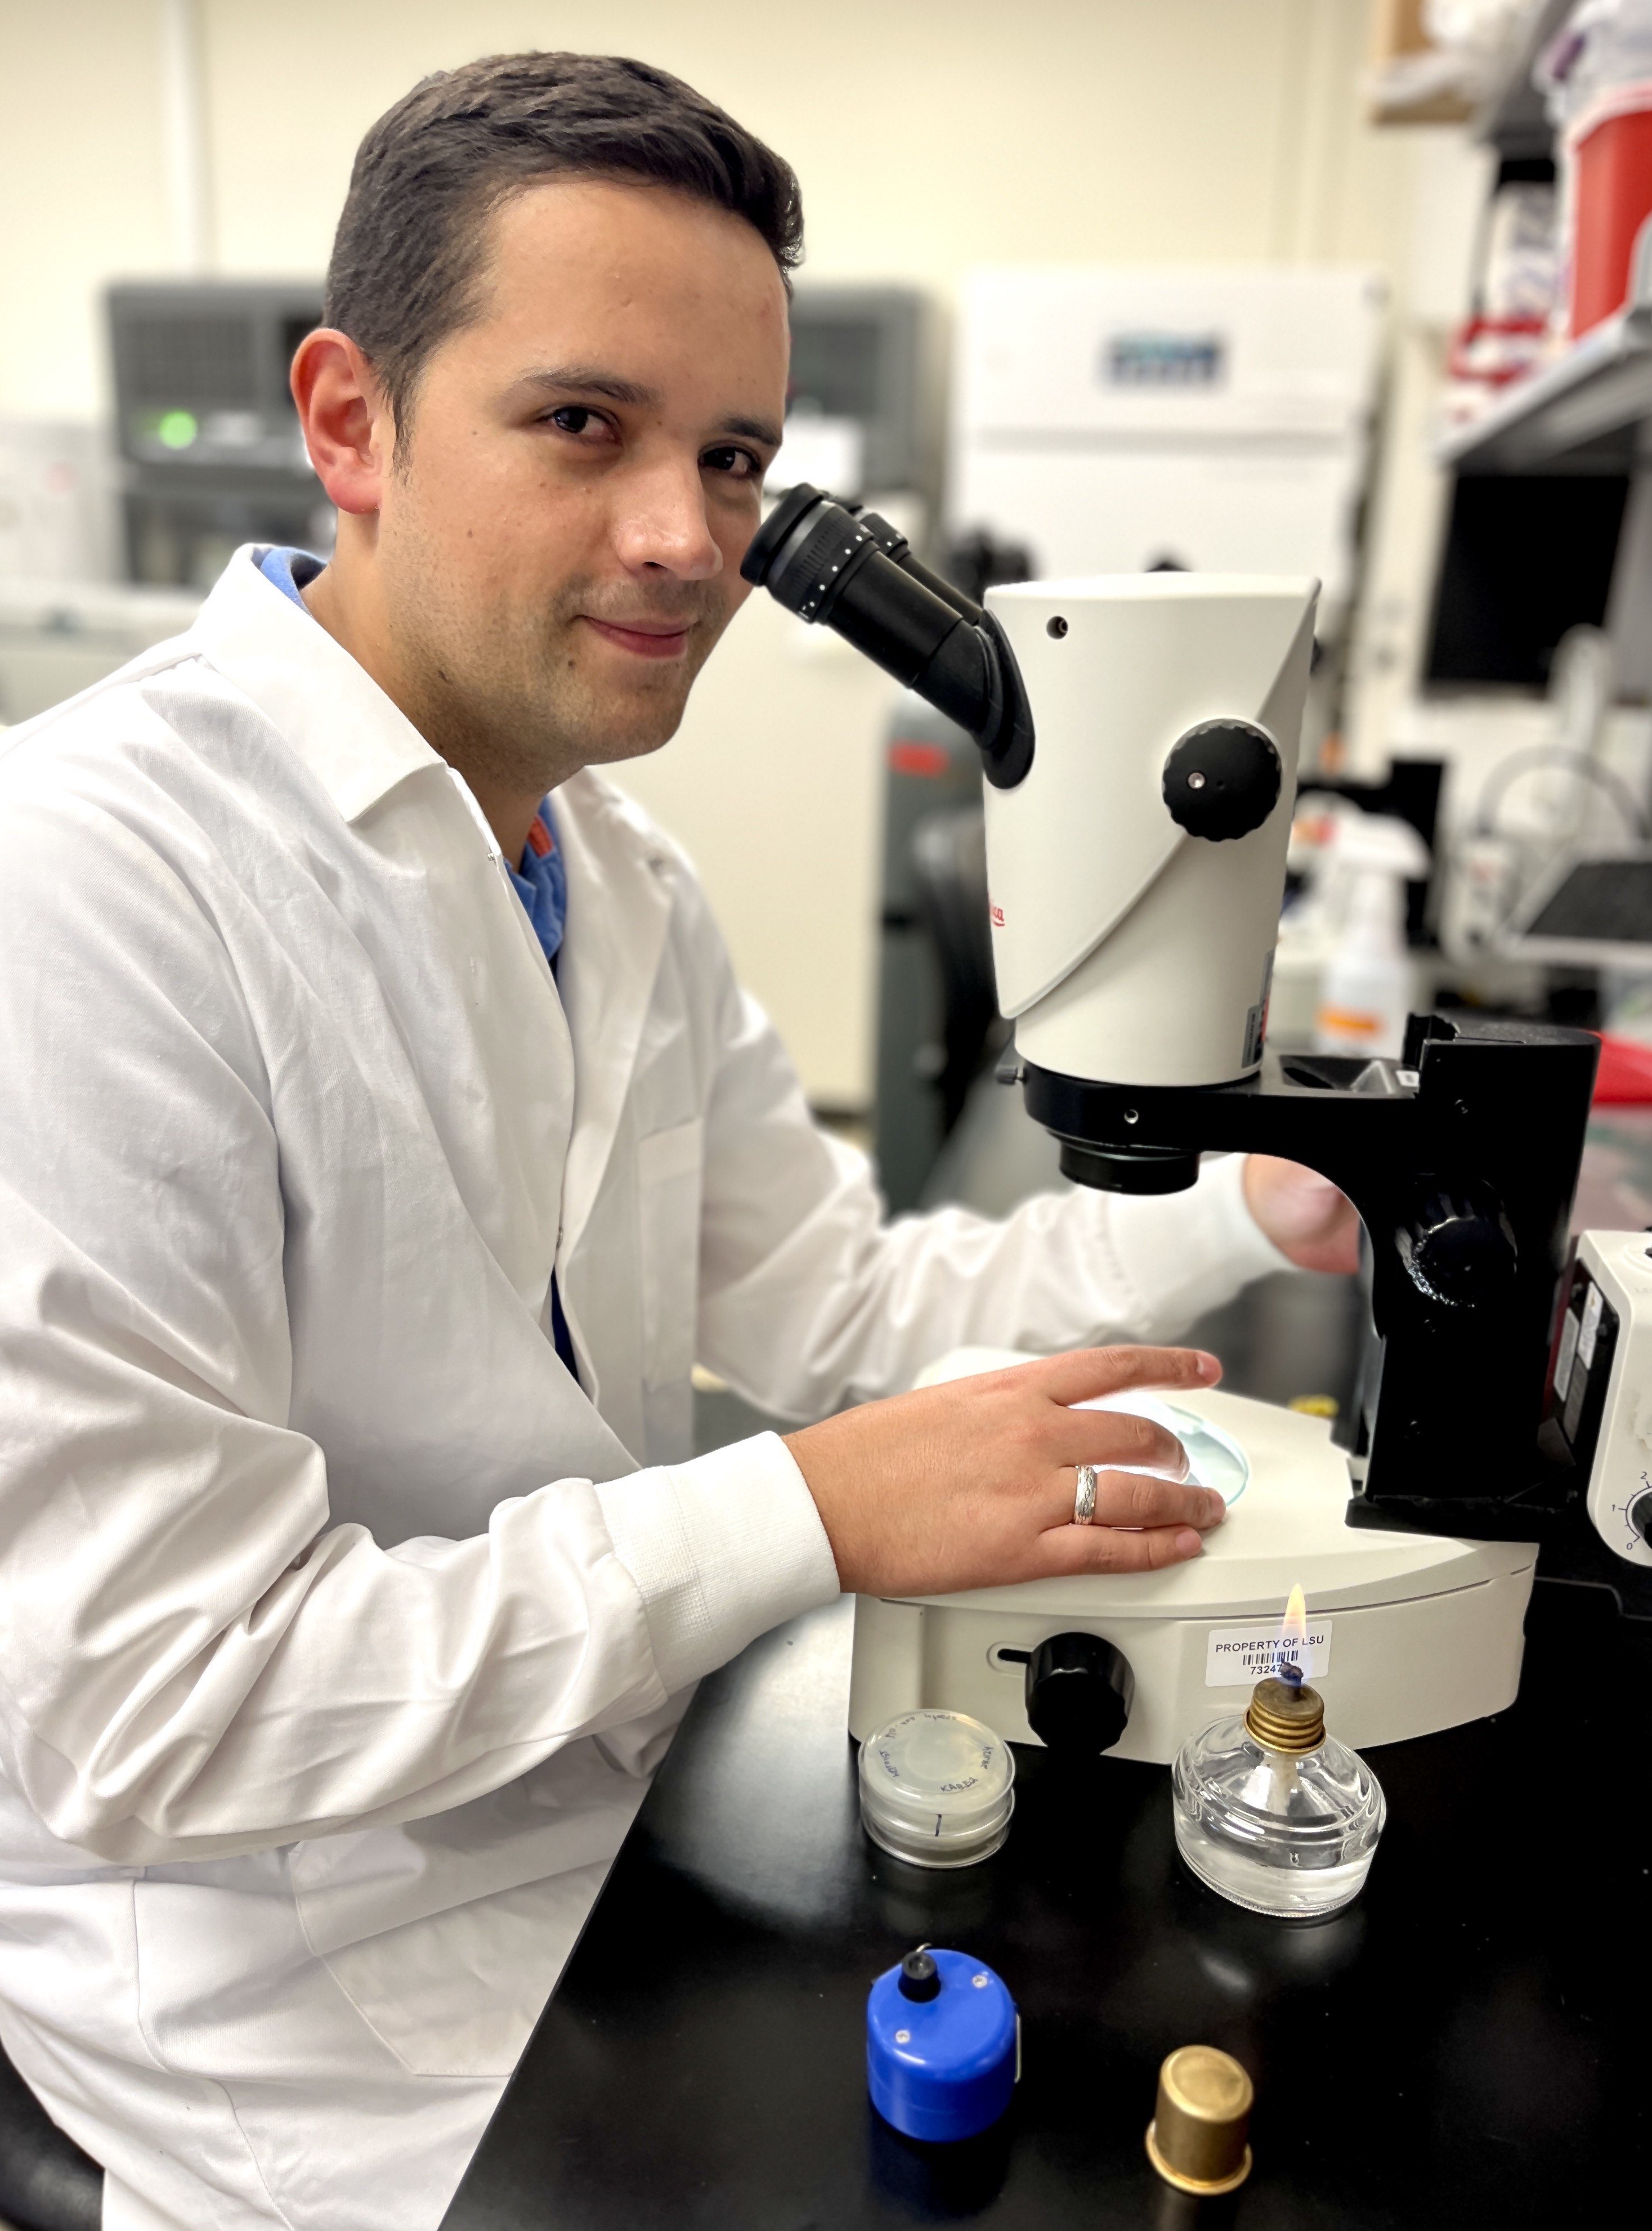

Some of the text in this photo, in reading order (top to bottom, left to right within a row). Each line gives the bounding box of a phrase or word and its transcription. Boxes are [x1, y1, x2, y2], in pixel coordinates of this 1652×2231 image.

[1640, 1471, 1647, 1480] 2
[1216, 1635, 1324, 1652] PROPERTY OF LSU
